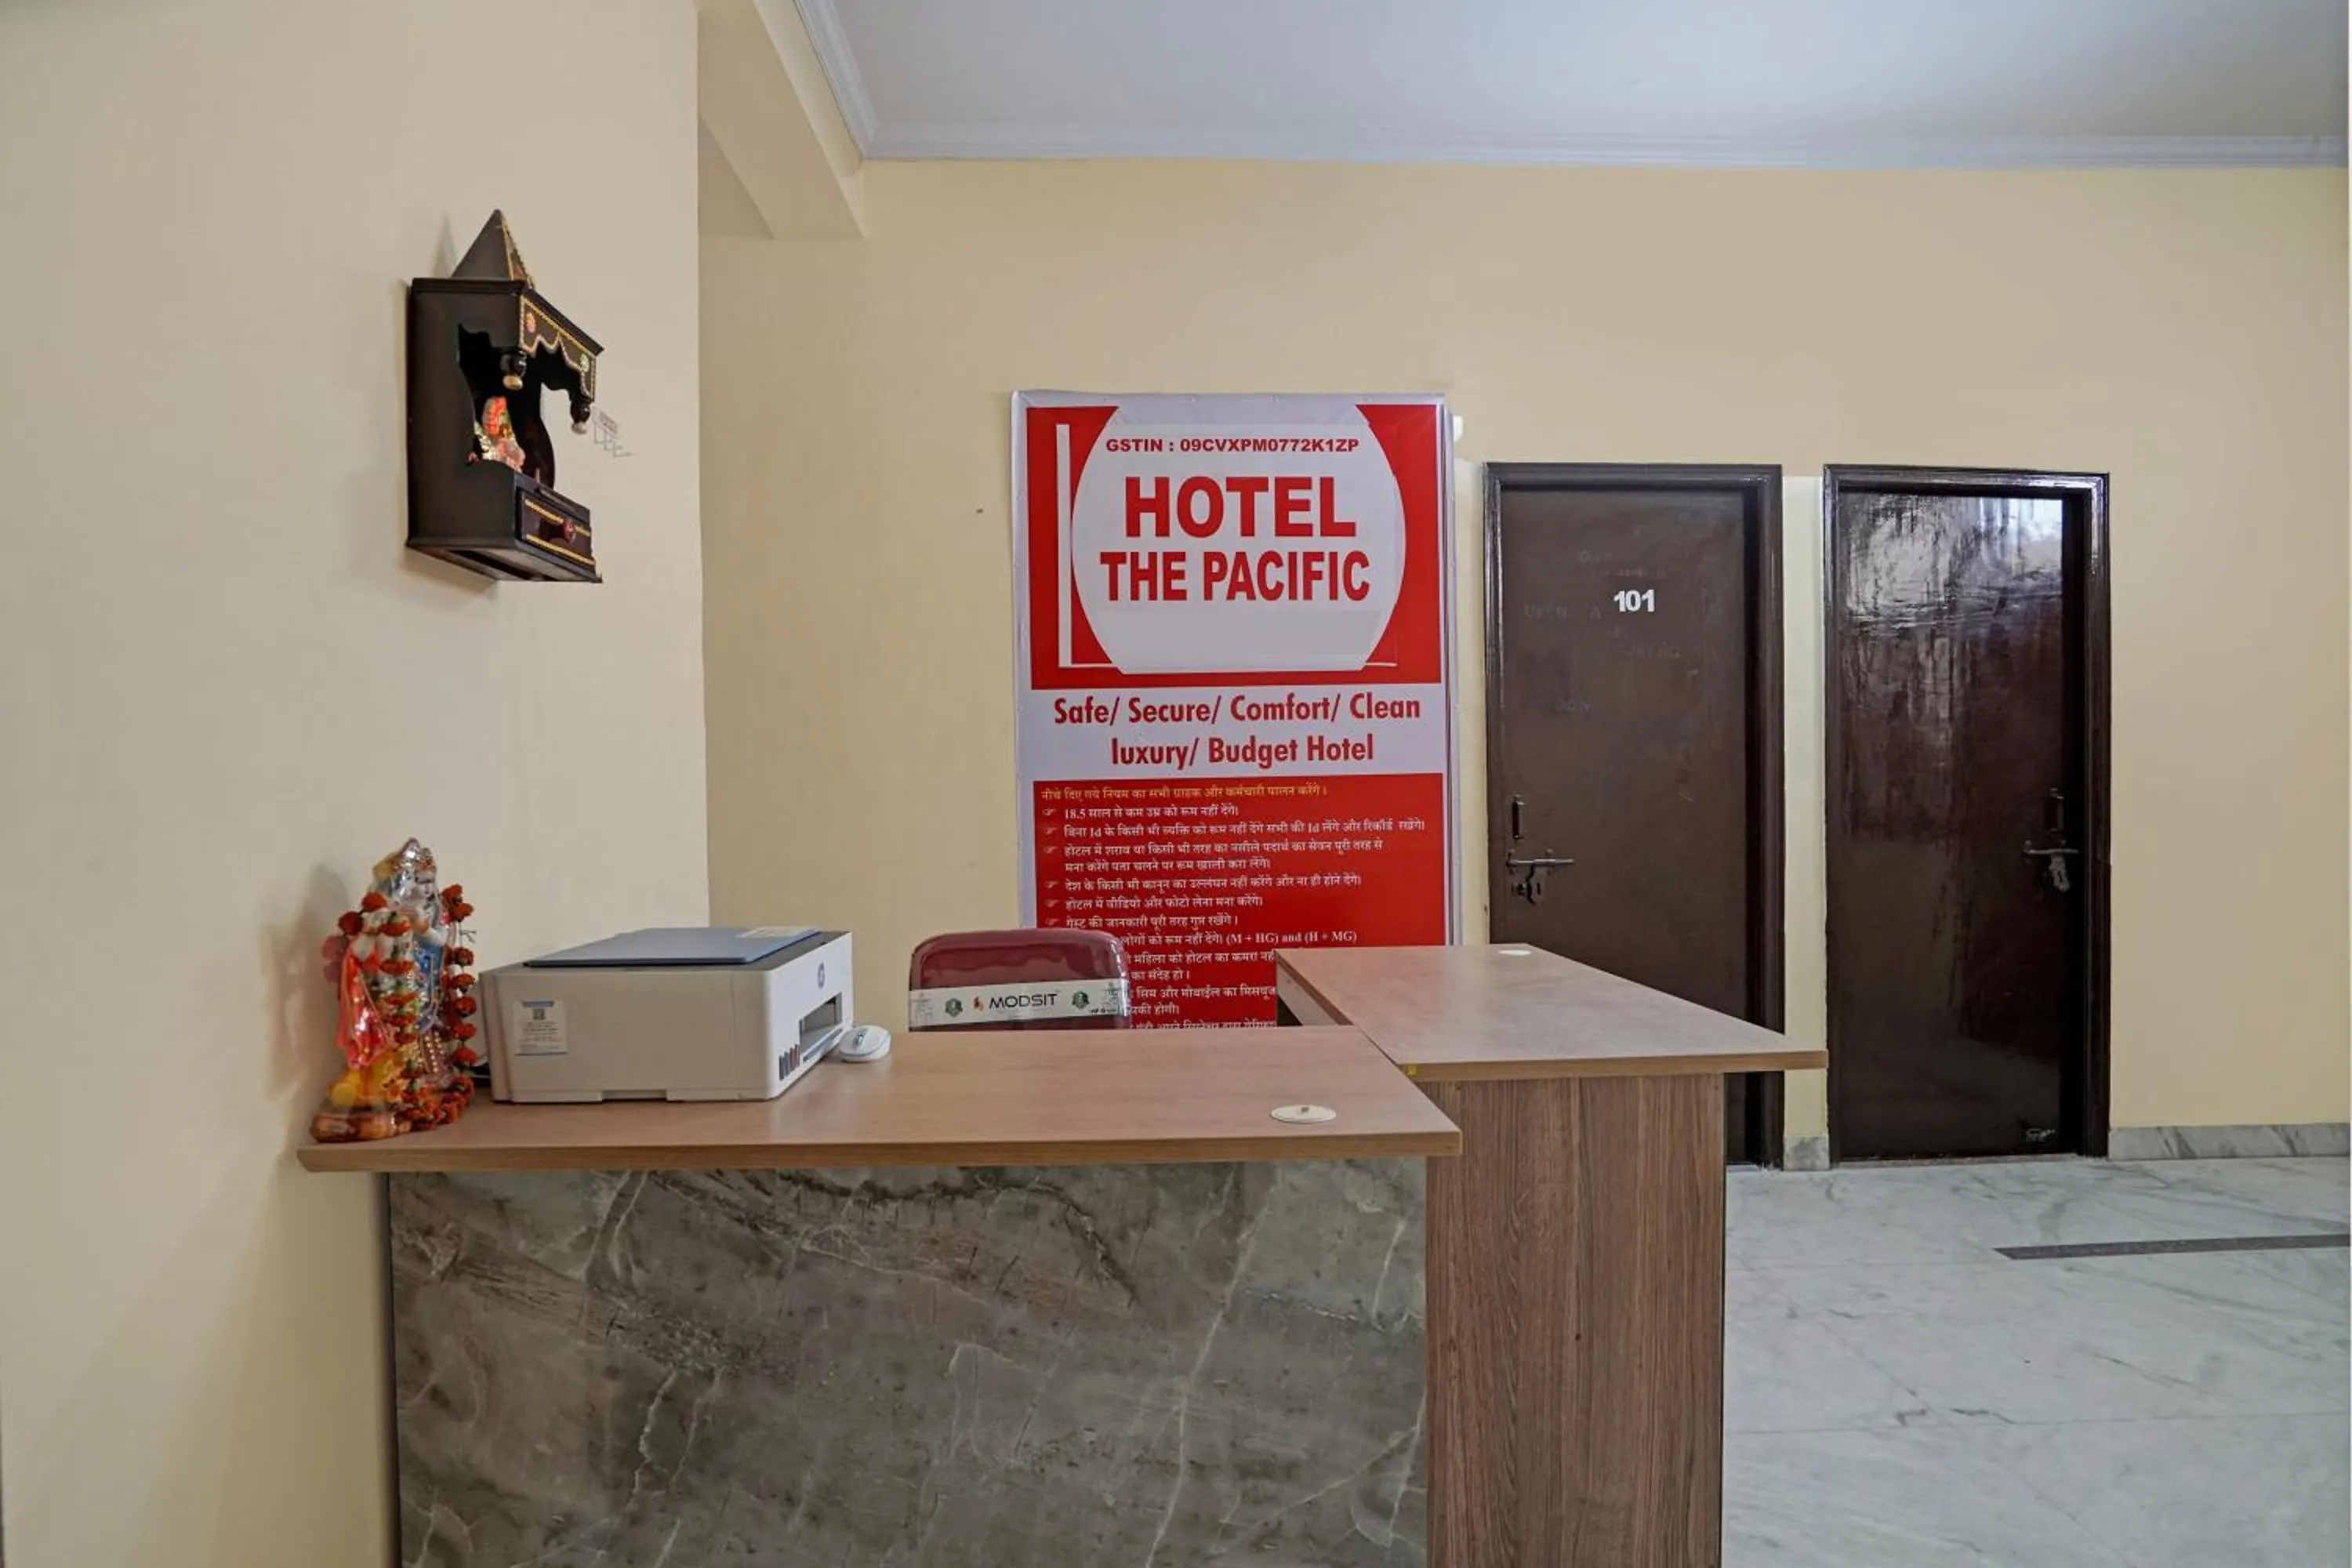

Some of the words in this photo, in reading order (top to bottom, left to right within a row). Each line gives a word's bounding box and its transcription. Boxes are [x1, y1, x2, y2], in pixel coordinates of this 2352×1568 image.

[1106, 438, 1163, 452] GSTIN
[1179, 438, 1359, 453] 09CVXPM0772K1ZP
[1125, 476, 1356, 538] HOTEL
[1100, 551, 1187, 601] THE
[1203, 550, 1370, 602] PACIFIC
[1613, 590, 1655, 612] 101
[1054, 696, 1119, 725] Safe/
[1128, 695, 1221, 724] Secure/
[1231, 693, 1341, 723] Comfort/
[1350, 691, 1421, 720] Clean
[1112, 738, 1200, 771] luxury/
[1208, 737, 1298, 769] Budget
[1307, 733, 1374, 762] Hotel
[1065, 809, 1085, 818] 18.5
[1282, 933, 1301, 942] and
[988, 993, 1058, 1010] MODSIT
